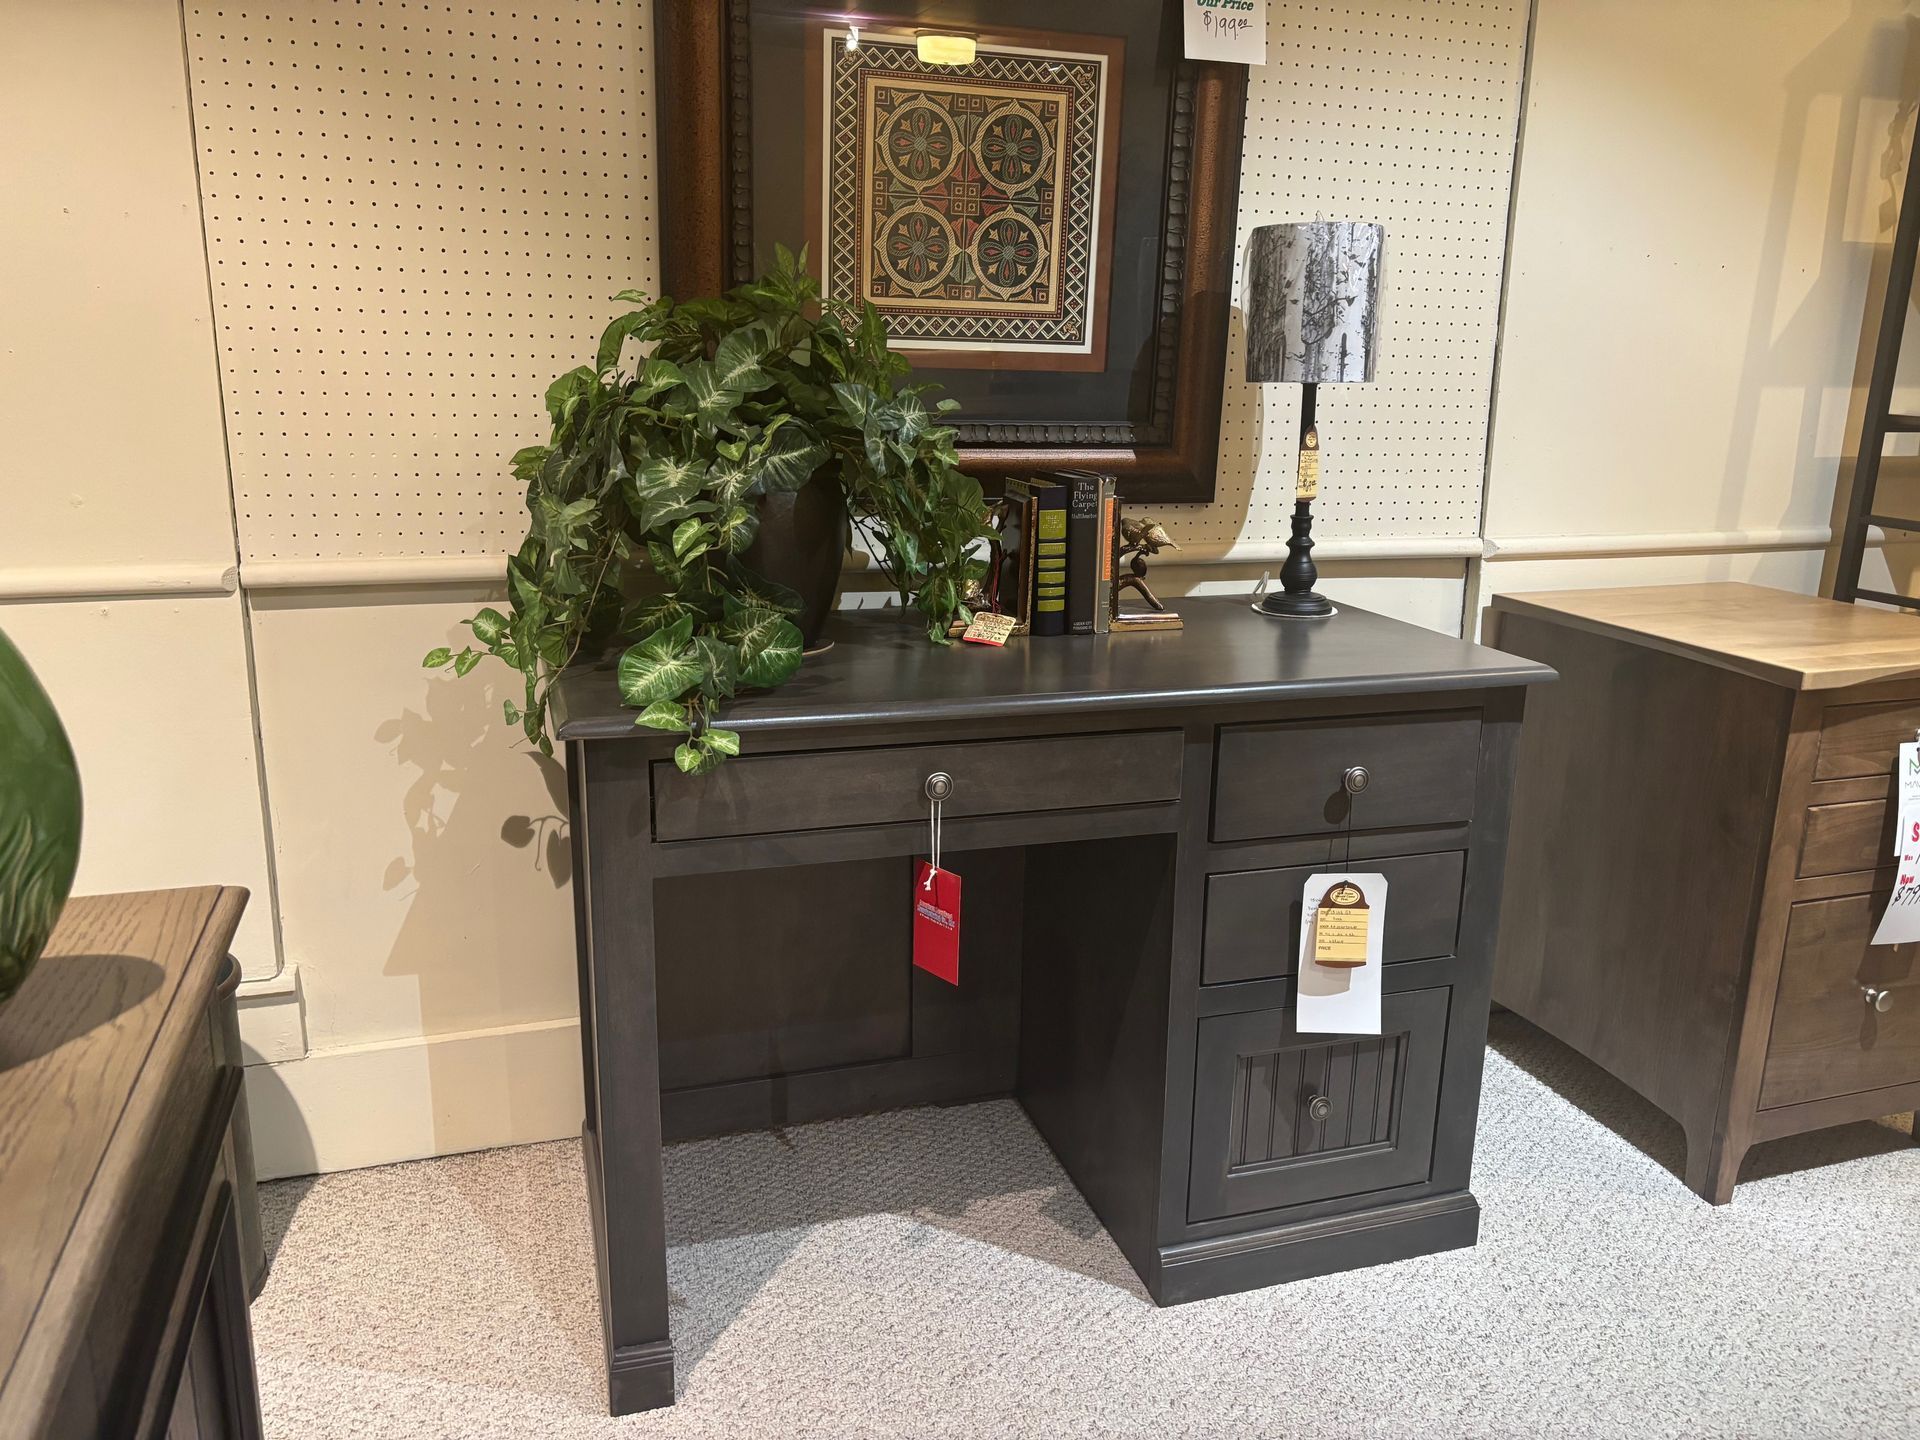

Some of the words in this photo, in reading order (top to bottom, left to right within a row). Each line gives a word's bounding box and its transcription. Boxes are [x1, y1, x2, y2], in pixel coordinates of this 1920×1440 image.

[1221, 0, 1254, 11] Price
[1078, 482, 1095, 491] The
[1073, 490, 1098, 501] Flying
[1071, 500, 1098, 510] Carpet
[1900, 874, 1915, 885] Now
